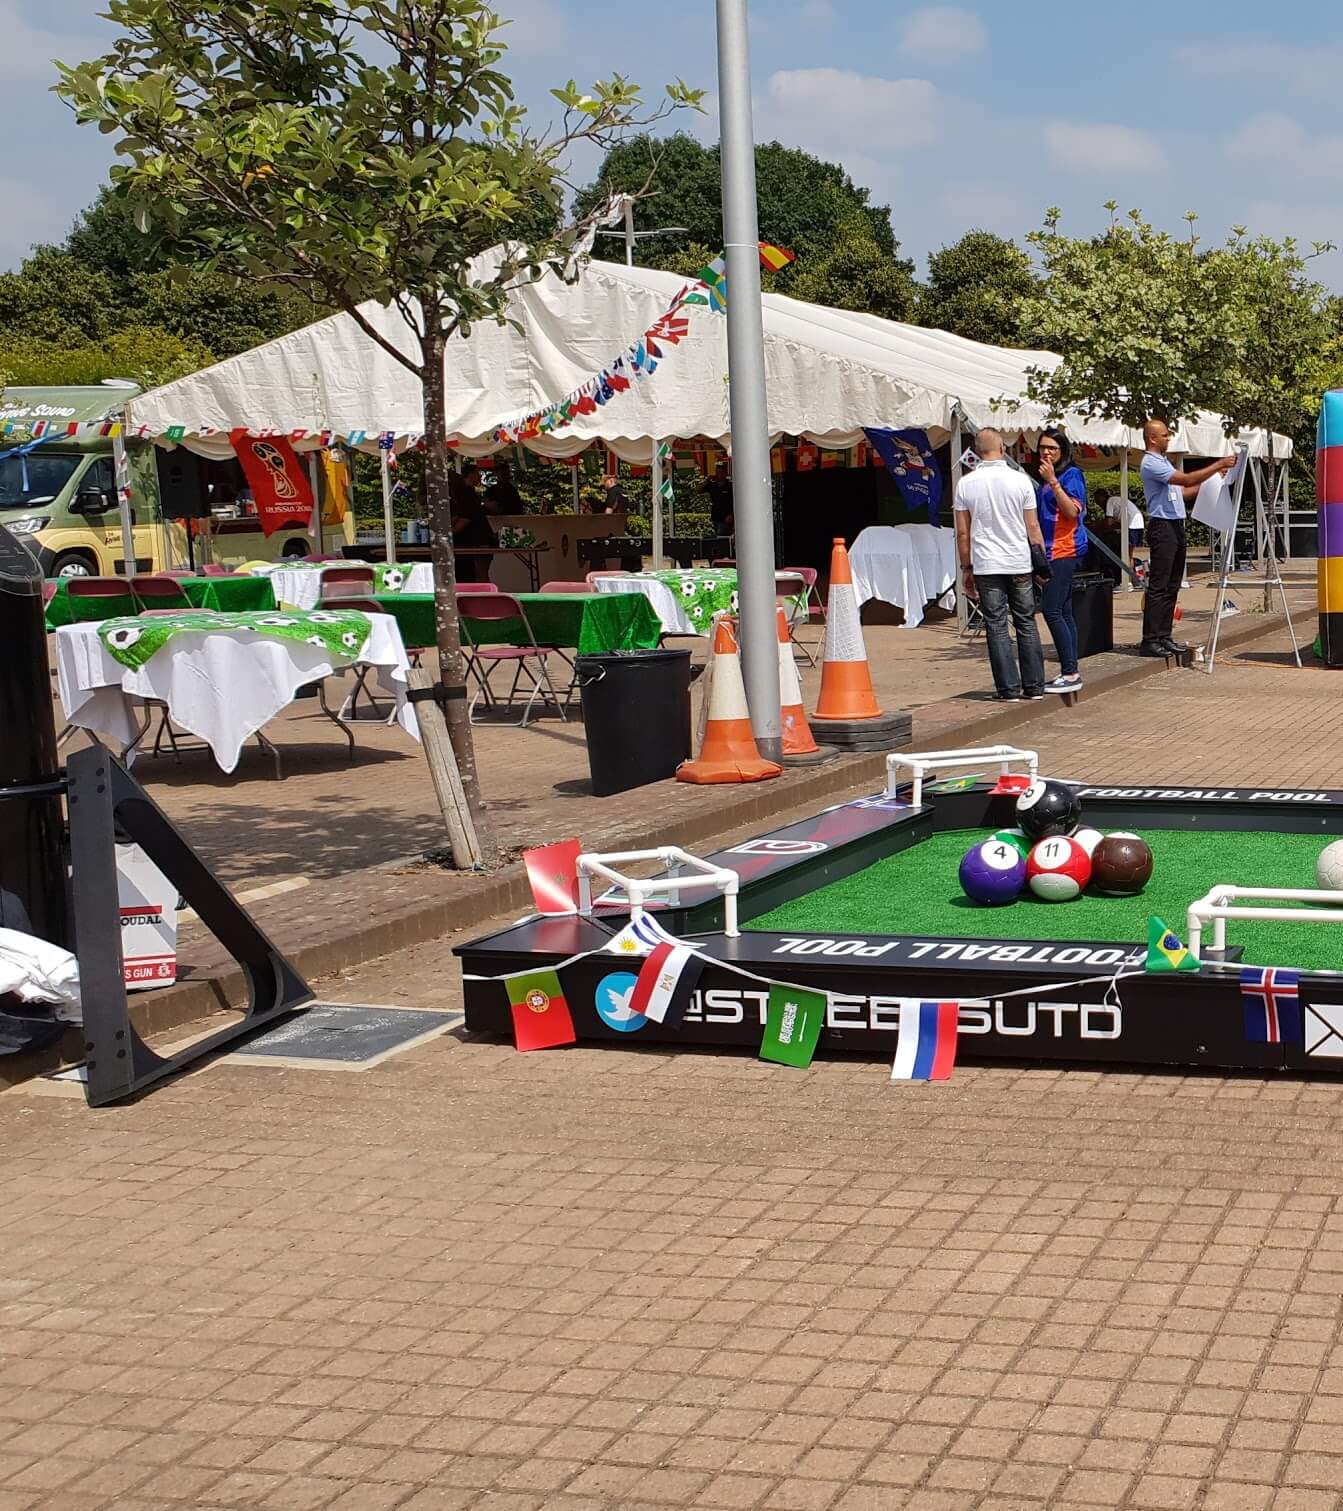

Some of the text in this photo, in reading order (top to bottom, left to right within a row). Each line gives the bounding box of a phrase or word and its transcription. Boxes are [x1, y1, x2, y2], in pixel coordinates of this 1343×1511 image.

[1077, 788, 1332, 802] FOOTBALL POOL
[993, 845, 1007, 859] 4
[1044, 843, 1059, 857] 11
[120, 915, 162, 926] OUDAL
[770, 937, 1148, 967] FOOTBALL POOL
[133, 967, 153, 978] GUN
